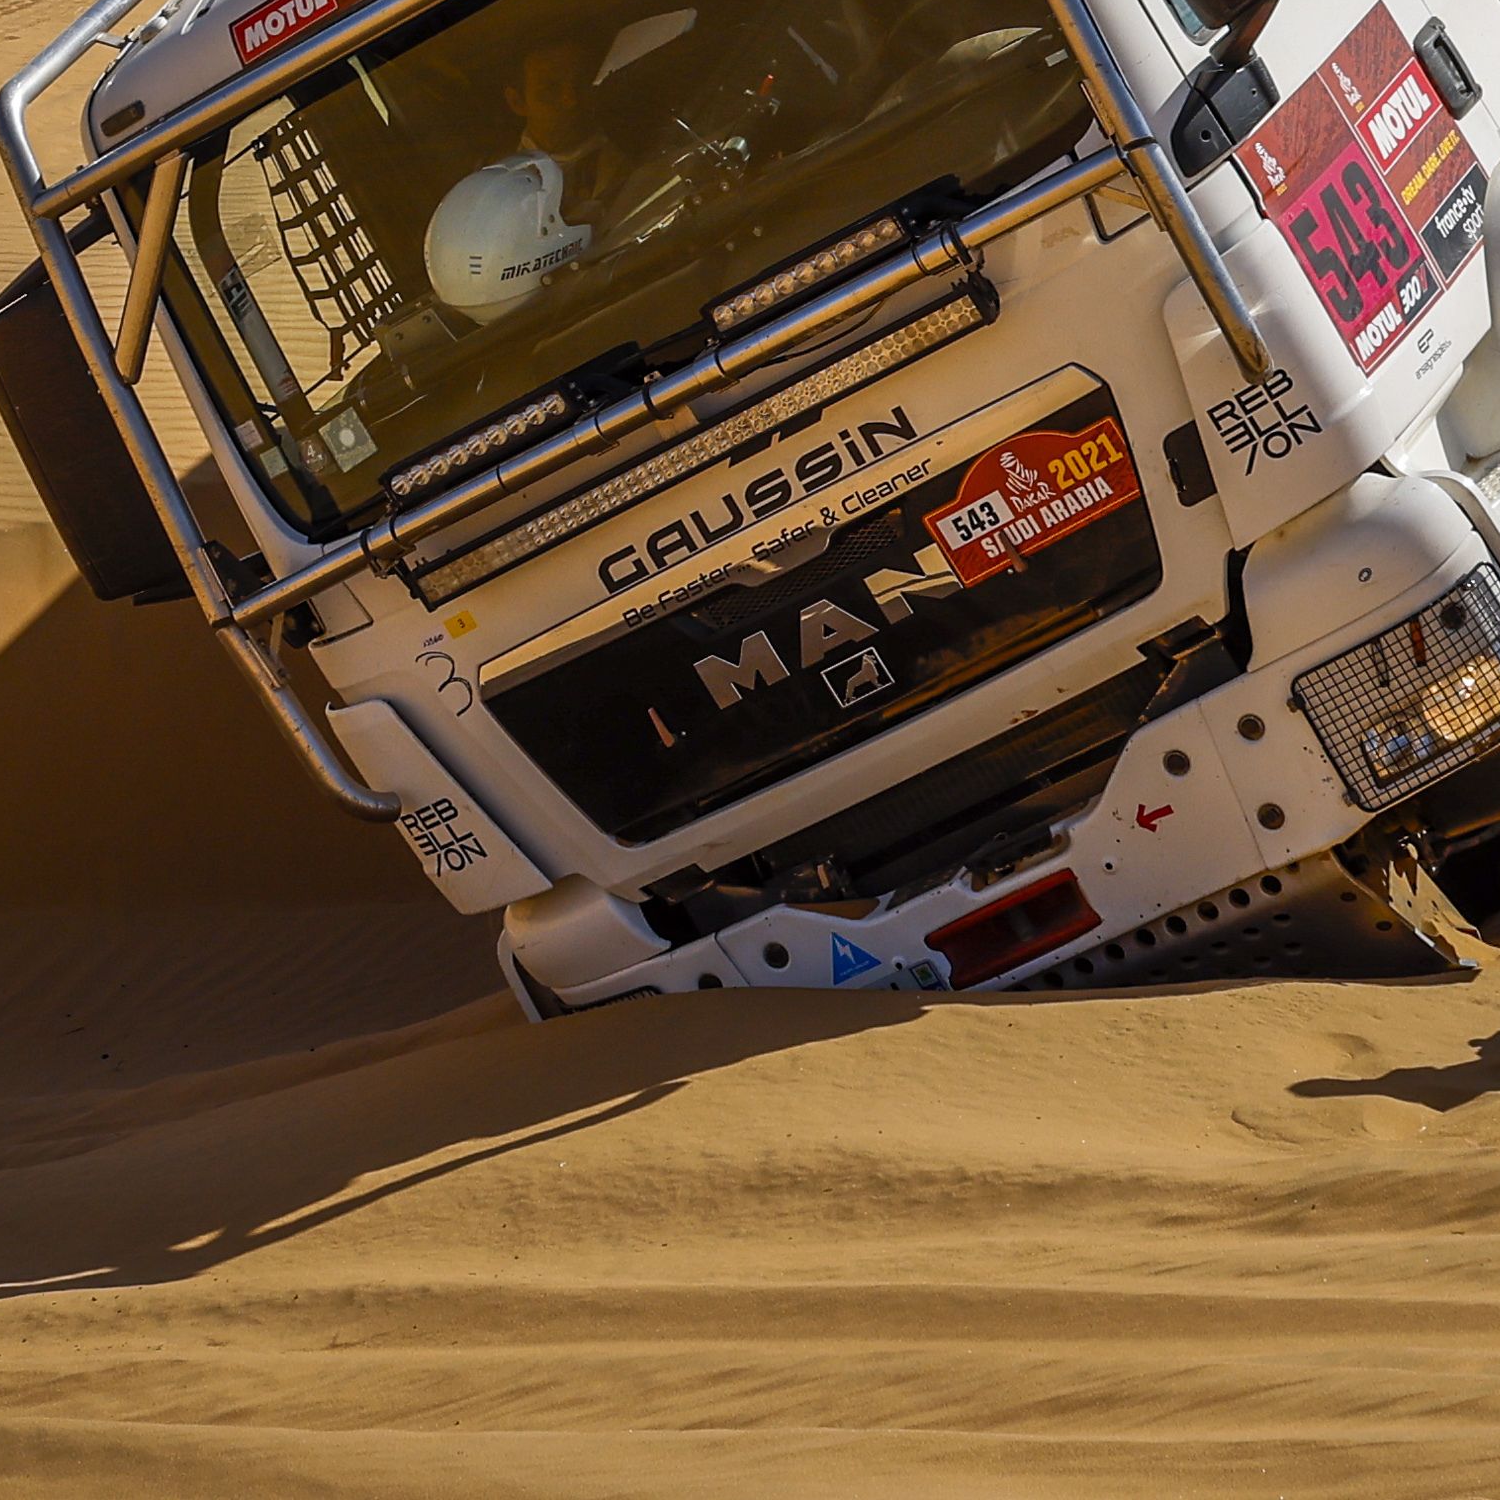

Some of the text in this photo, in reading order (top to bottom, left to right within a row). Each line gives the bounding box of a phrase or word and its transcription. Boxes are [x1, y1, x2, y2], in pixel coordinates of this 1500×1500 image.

[1367, 74, 1432, 160] MOTUL
[1288, 161, 1410, 322] 543
[1462, 203, 1485, 240] sport
[1354, 301, 1403, 362] MOTUL
[1047, 433, 1124, 490] 2021
[951, 500, 1001, 542] 543
[1010, 481, 1057, 513] DAKAR
[1042, 476, 1114, 528] ARABIA
[622, 605, 656, 629] Be
[658, 560, 733, 610] Faster
[752, 519, 815, 562] Safer
[819, 506, 840, 528] &
[841, 457, 932, 514] Cleaner
[693, 542, 963, 710] MAN
[415, 651, 473, 717] 3
